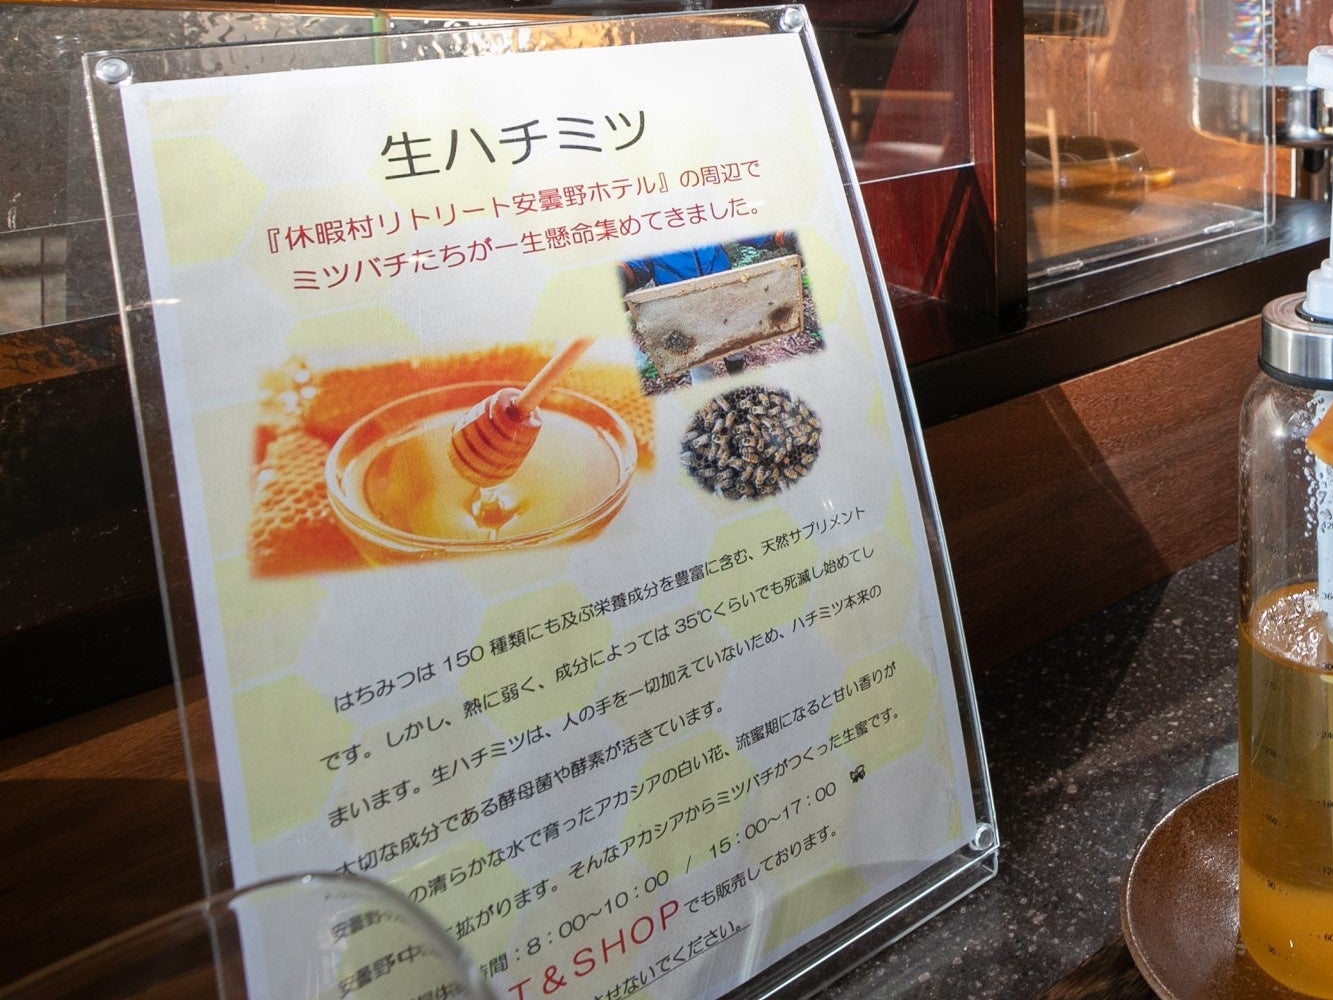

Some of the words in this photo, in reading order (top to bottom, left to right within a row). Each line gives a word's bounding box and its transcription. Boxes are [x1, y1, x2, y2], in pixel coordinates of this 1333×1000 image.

[381, 111, 645, 180] 生ハチミツ
[267, 160, 761, 254] 『休暇村リトリート安曇野ホテル』の周辺で
[294, 198, 758, 290] ミツバチたちが一生懸命集めてきました。
